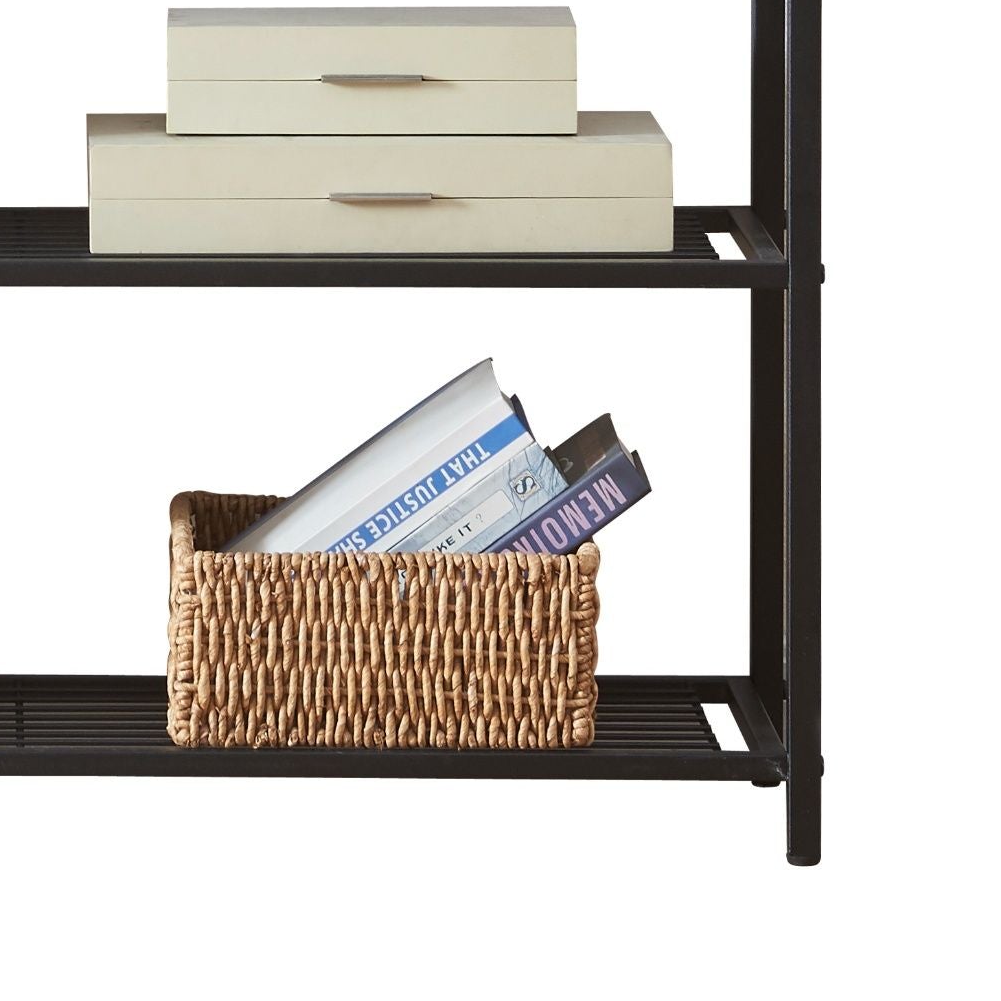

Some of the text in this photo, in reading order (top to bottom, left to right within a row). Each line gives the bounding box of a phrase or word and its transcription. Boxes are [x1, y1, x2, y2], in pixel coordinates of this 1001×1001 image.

[440, 442, 491, 486] THAT
[365, 476, 439, 539] JUSTICE
[457, 522, 472, 537] IT
